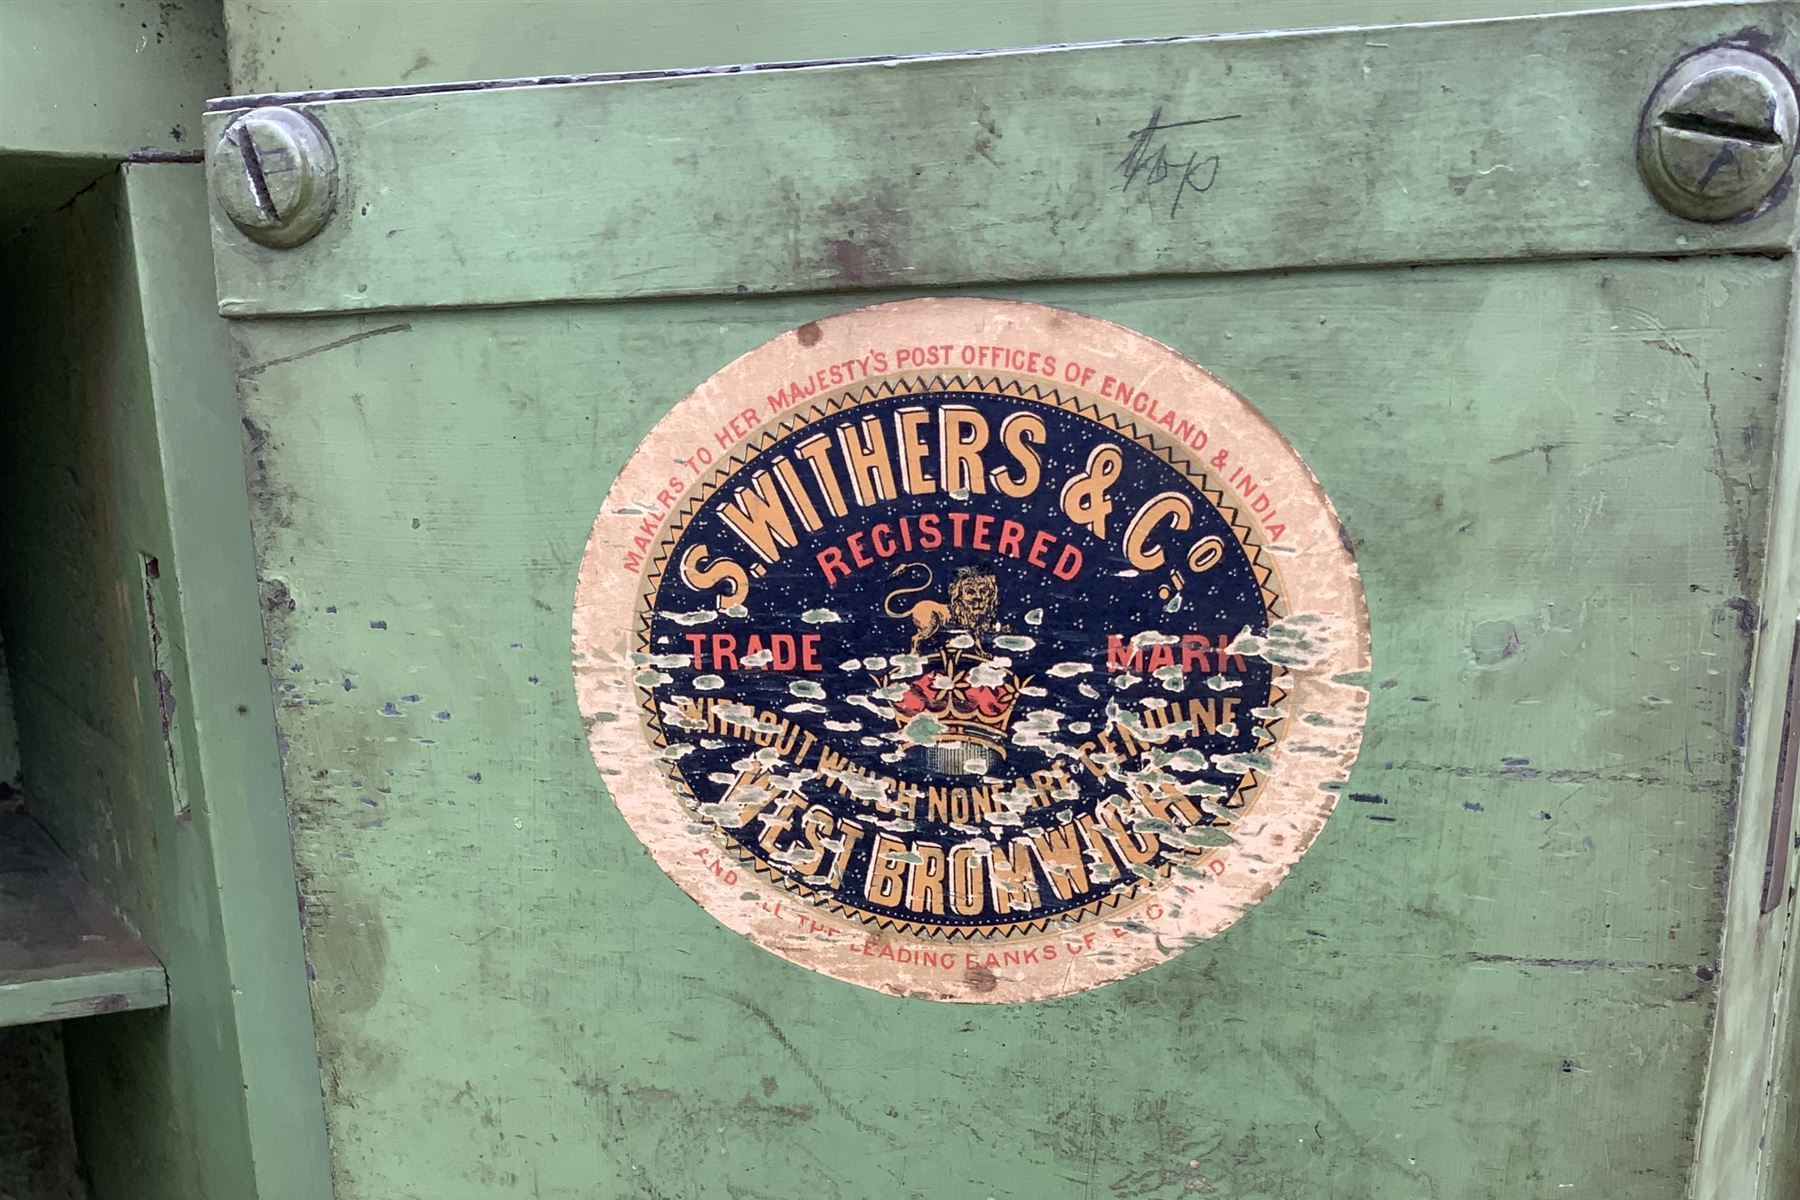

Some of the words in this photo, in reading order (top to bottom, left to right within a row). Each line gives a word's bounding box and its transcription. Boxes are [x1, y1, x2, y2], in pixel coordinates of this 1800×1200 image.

[686, 447, 713, 475] TO
[715, 407, 762, 450] HER
[767, 348, 888, 414] MAJESTY'S
[896, 345, 953, 369] POST
[961, 345, 1056, 377] OFFICES
[1064, 362, 1096, 387] OF
[1100, 376, 1208, 451] ENGLAND
[1210, 450, 1227, 472] &
[1228, 467, 1287, 542] INDIA
[1060, 443, 1124, 540] &
[816, 512, 1084, 587] REGISTERED
[686, 633, 823, 671] TRADE
[1107, 633, 1248, 673] MARK
[928, 783, 1004, 824] NONE
[864, 778, 1203, 915] BROMWICH
[965, 944, 1058, 971] BANKS
